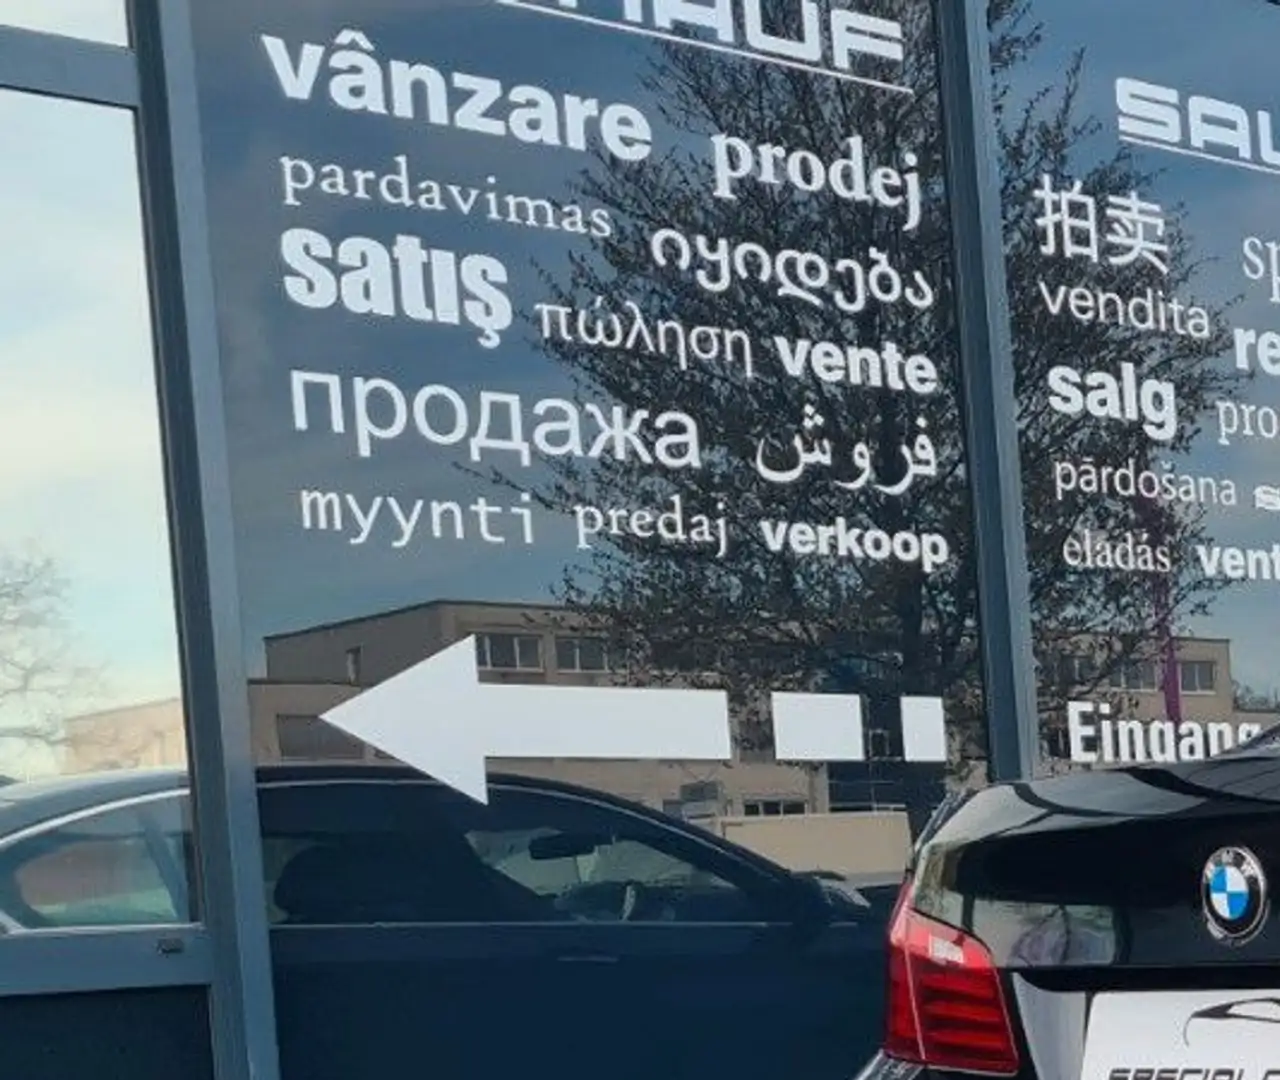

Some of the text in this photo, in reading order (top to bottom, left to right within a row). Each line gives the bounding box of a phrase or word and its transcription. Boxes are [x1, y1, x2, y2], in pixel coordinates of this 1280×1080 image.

[261, 29, 653, 161] vânzare
[280, 155, 613, 238] pardavimas
[711, 135, 919, 230] prodej
[1034, 175, 1168, 273] 拍卖
[282, 229, 511, 347] satış
[652, 222, 932, 311] იყიდება
[534, 300, 752, 378] πώληση
[1040, 283, 1209, 337] vendita
[775, 337, 936, 392] vente
[1049, 363, 1176, 439] salg
[292, 368, 700, 467] продажа
[302, 490, 533, 547] myynti
[1056, 459, 1237, 502] pārdošana
[574, 495, 725, 557] predaj
[761, 518, 947, 572] verkoop
[1064, 529, 1170, 571] eladás
